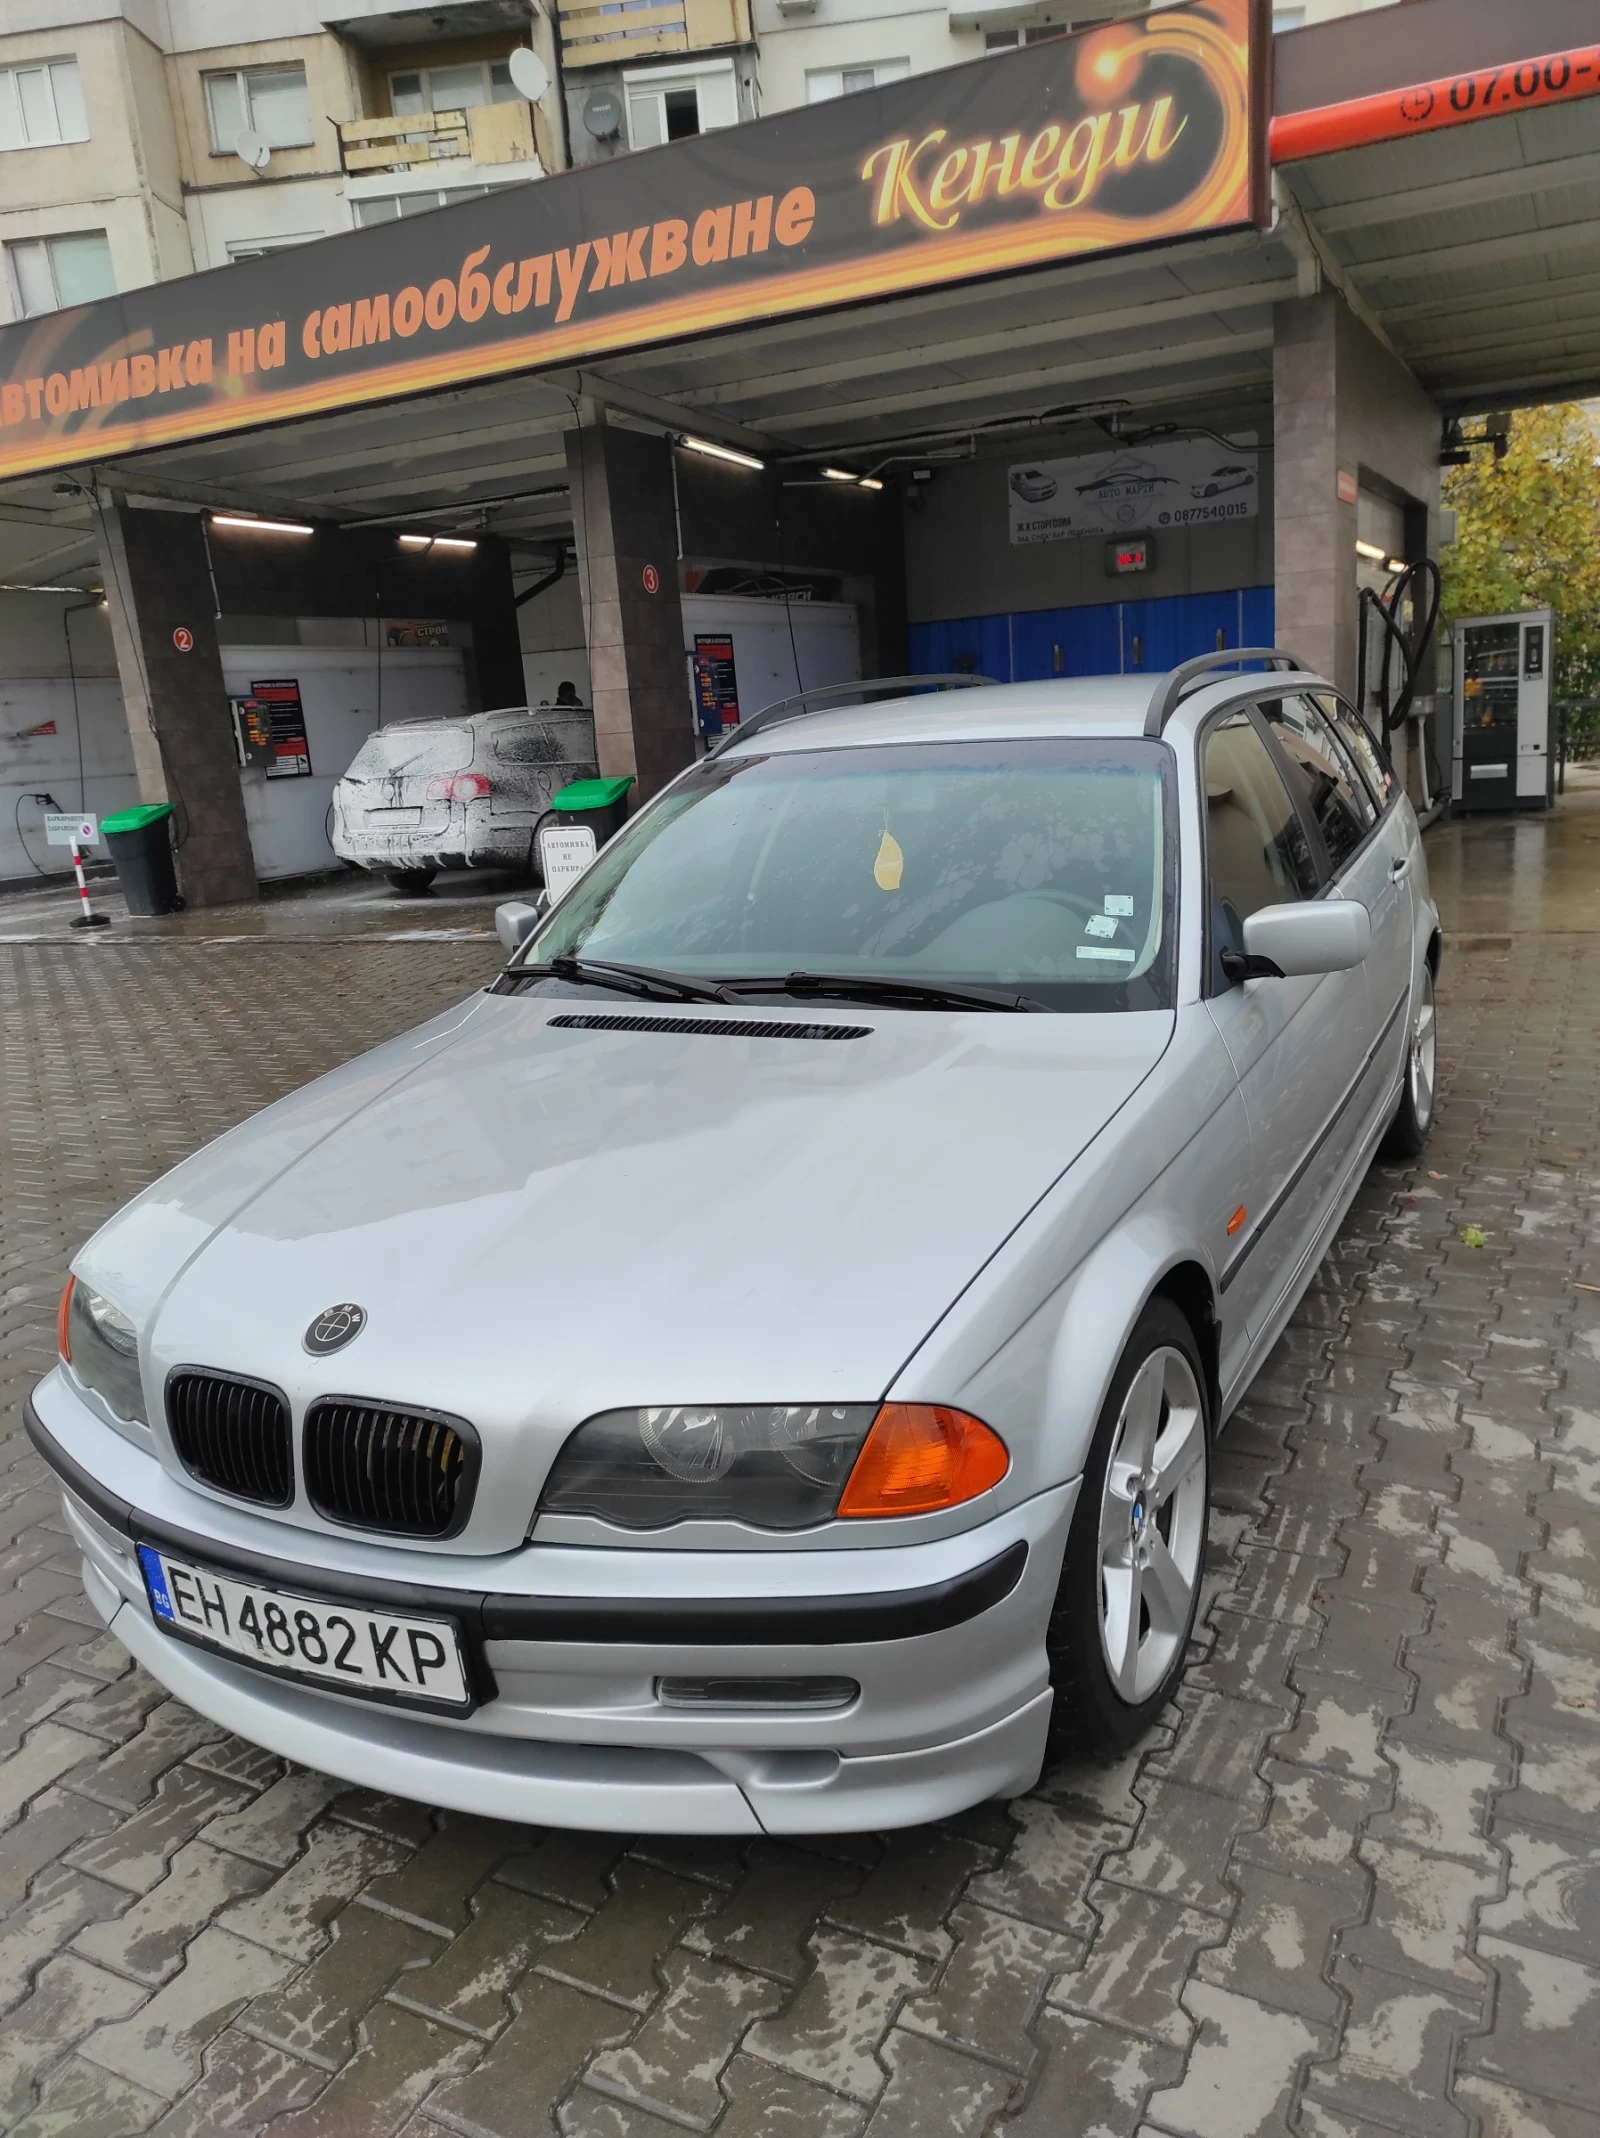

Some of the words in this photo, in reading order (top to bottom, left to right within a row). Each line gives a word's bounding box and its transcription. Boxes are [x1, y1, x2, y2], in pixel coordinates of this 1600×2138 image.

[861, 96, 1189, 230] Кенеди
[0, 338, 213, 426] втомивка
[228, 318, 286, 377] на
[302, 187, 816, 359] самообслужване
[1125, 483, 1154, 496] МАРТИ
[1174, 502, 1247, 522] 0877540015
[1032, 517, 1071, 531] СТОРГОЗИЯ
[547, 841, 590, 849] АВТОМИВКА
[562, 853, 572, 861] НЕ
[323, 1305, 361, 1322] BMW
[153, 1588, 170, 1609] BG
